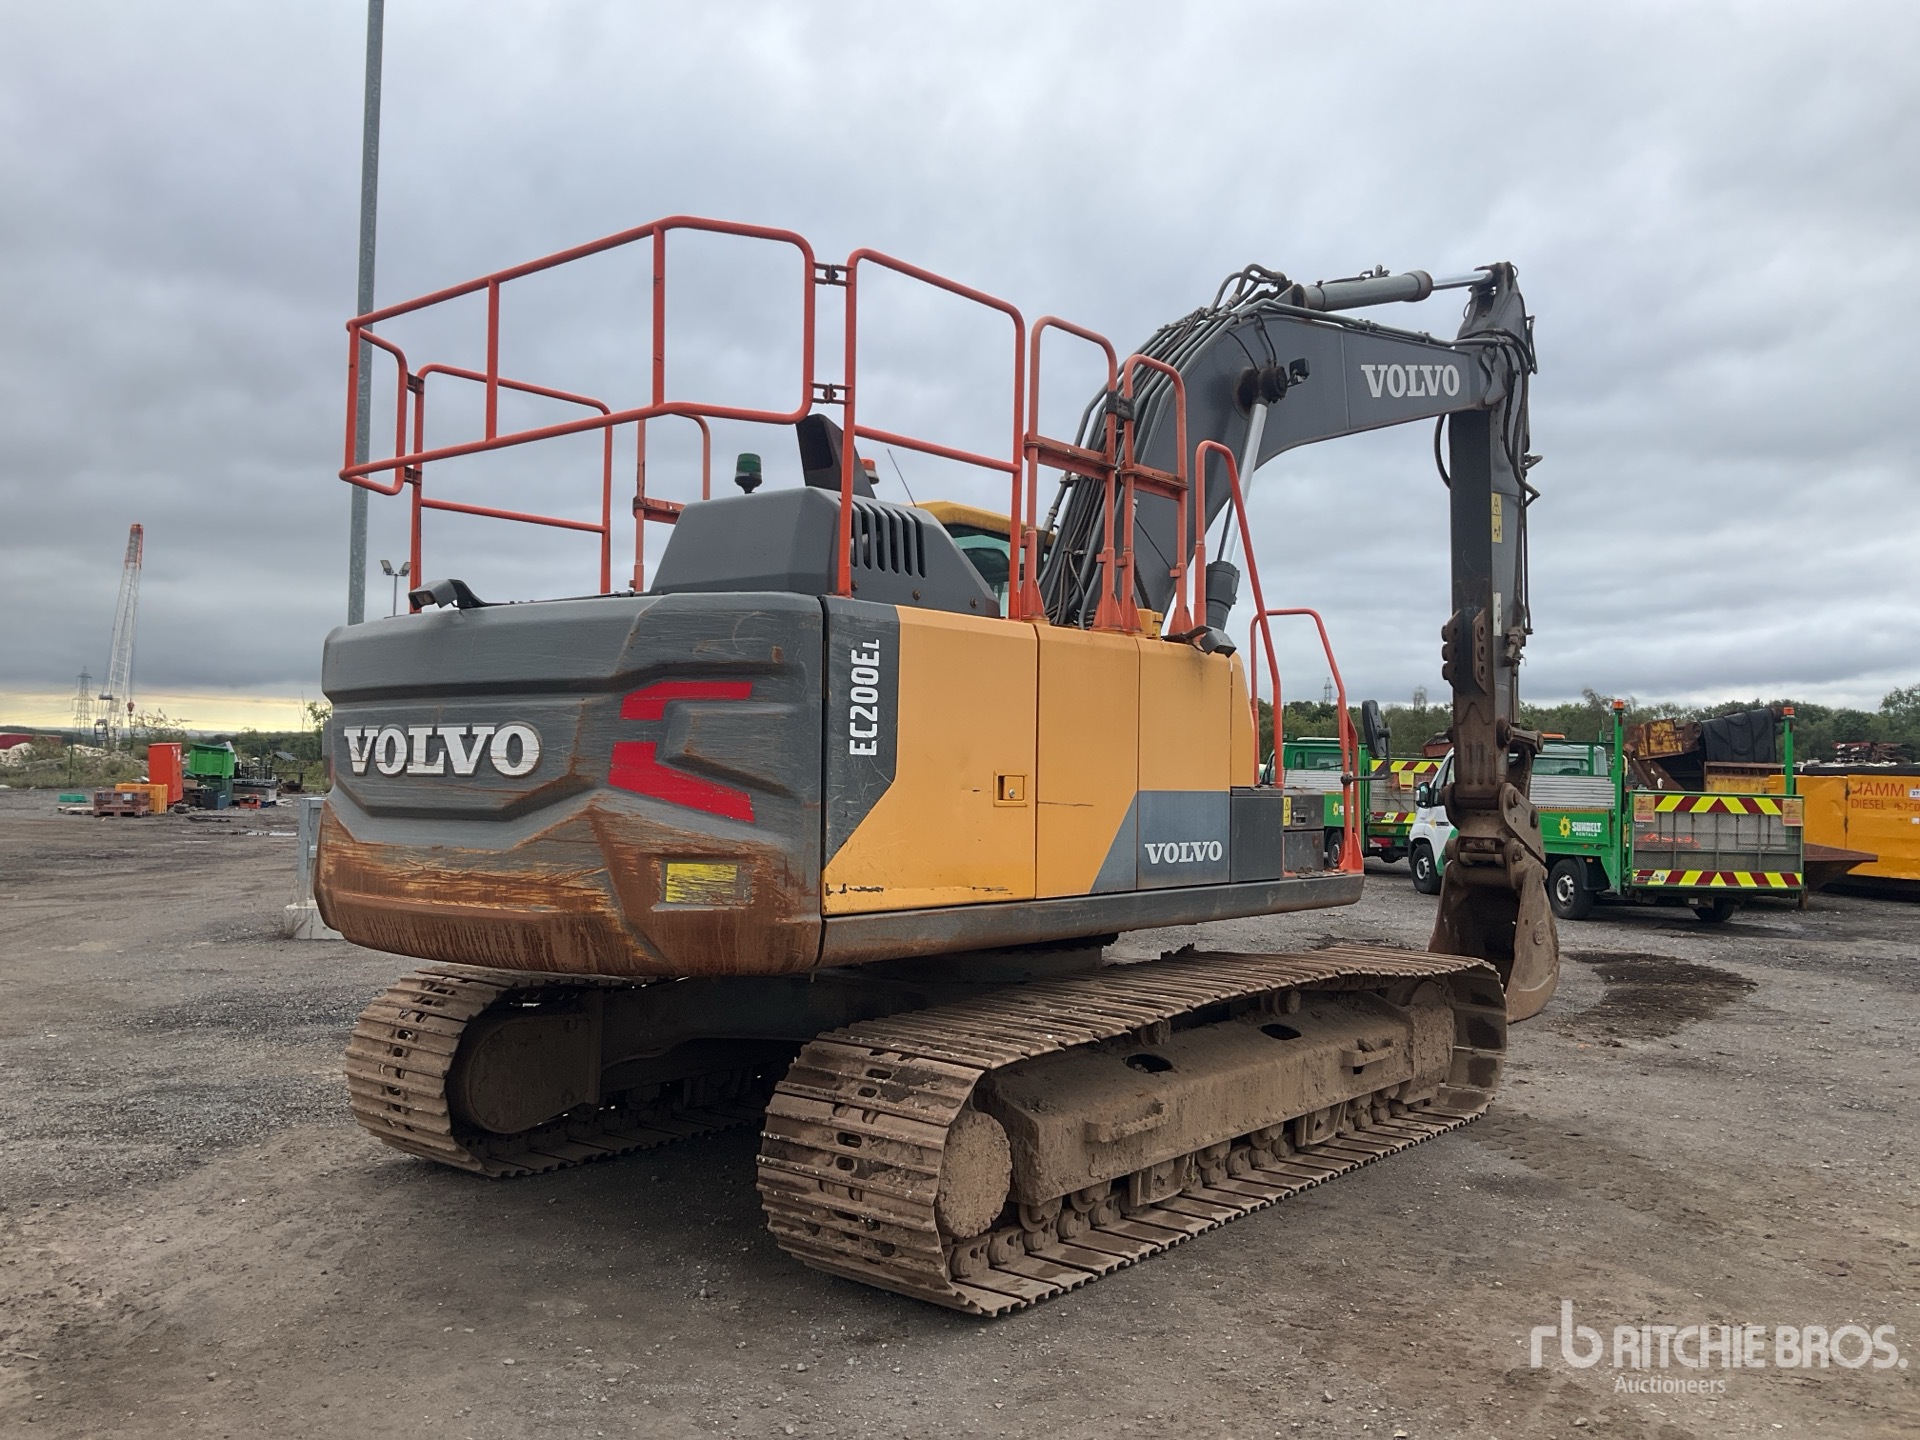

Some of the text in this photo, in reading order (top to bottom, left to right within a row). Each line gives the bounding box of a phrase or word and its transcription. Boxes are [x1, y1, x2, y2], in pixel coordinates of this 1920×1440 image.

[1361, 364, 1460, 398] VOLVO
[849, 639, 880, 756] EC200EL
[343, 723, 542, 777] VOLVO
[1851, 798, 1887, 810] DIESEL
[1144, 841, 1223, 865] VOLVO
